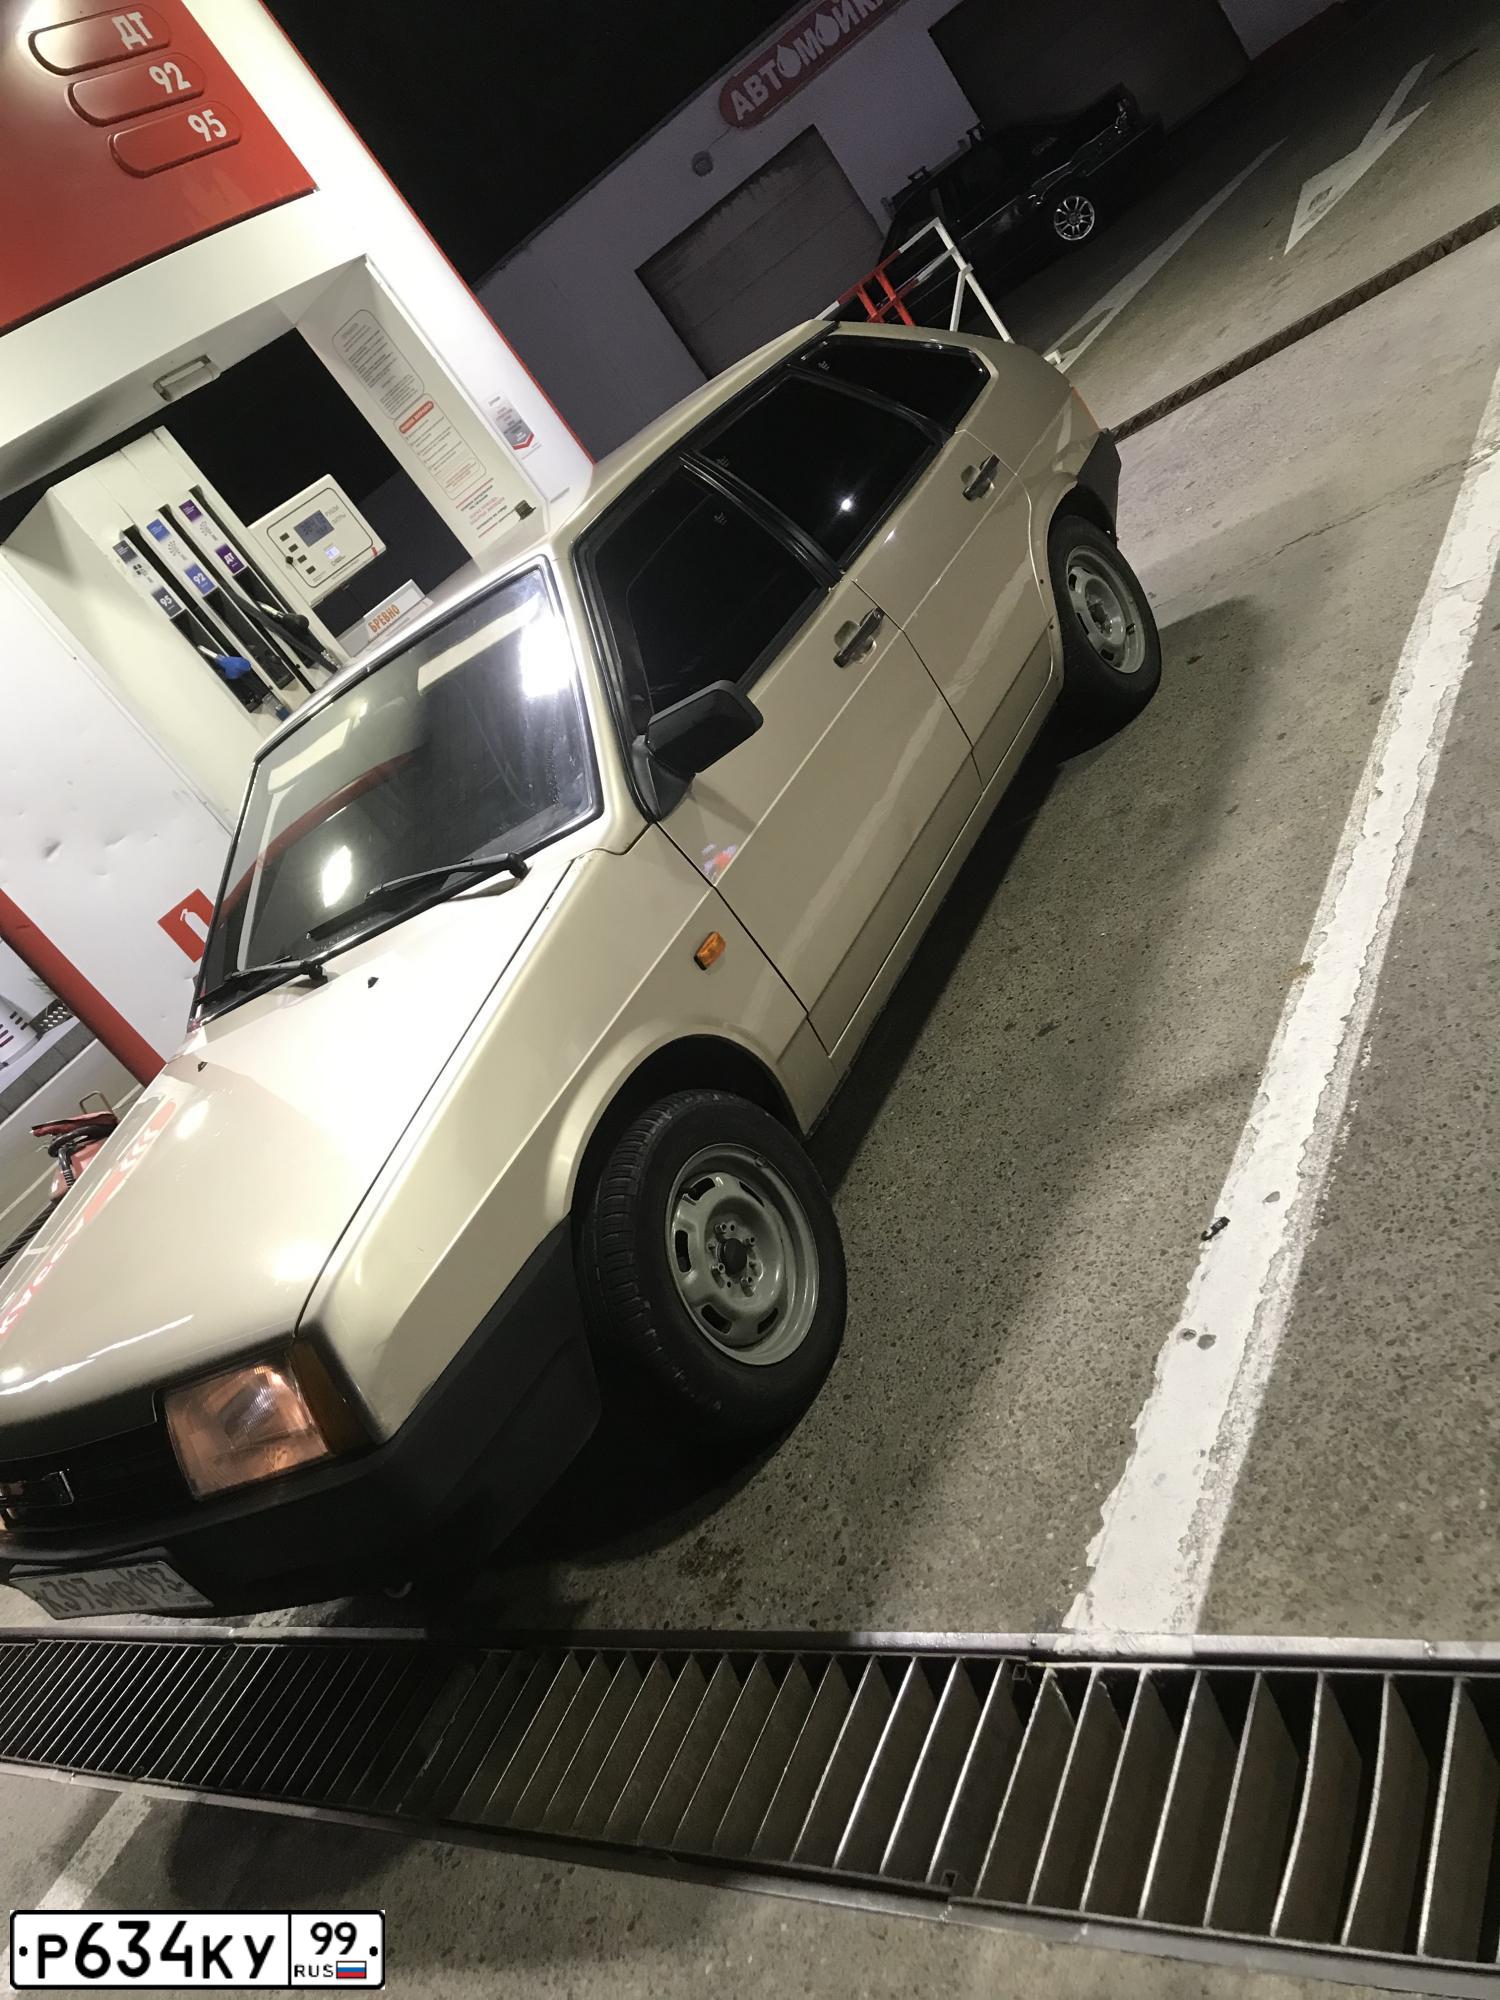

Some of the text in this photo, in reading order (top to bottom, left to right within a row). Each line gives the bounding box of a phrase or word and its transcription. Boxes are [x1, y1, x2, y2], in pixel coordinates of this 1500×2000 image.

[112, 12, 153, 50] ДТ
[149, 62, 191, 94] 92
[187, 109, 227, 142] 95
[193, 573, 206, 584] 92
[160, 595, 172, 606] 95
[368, 604, 400, 633] БРЕВНО
